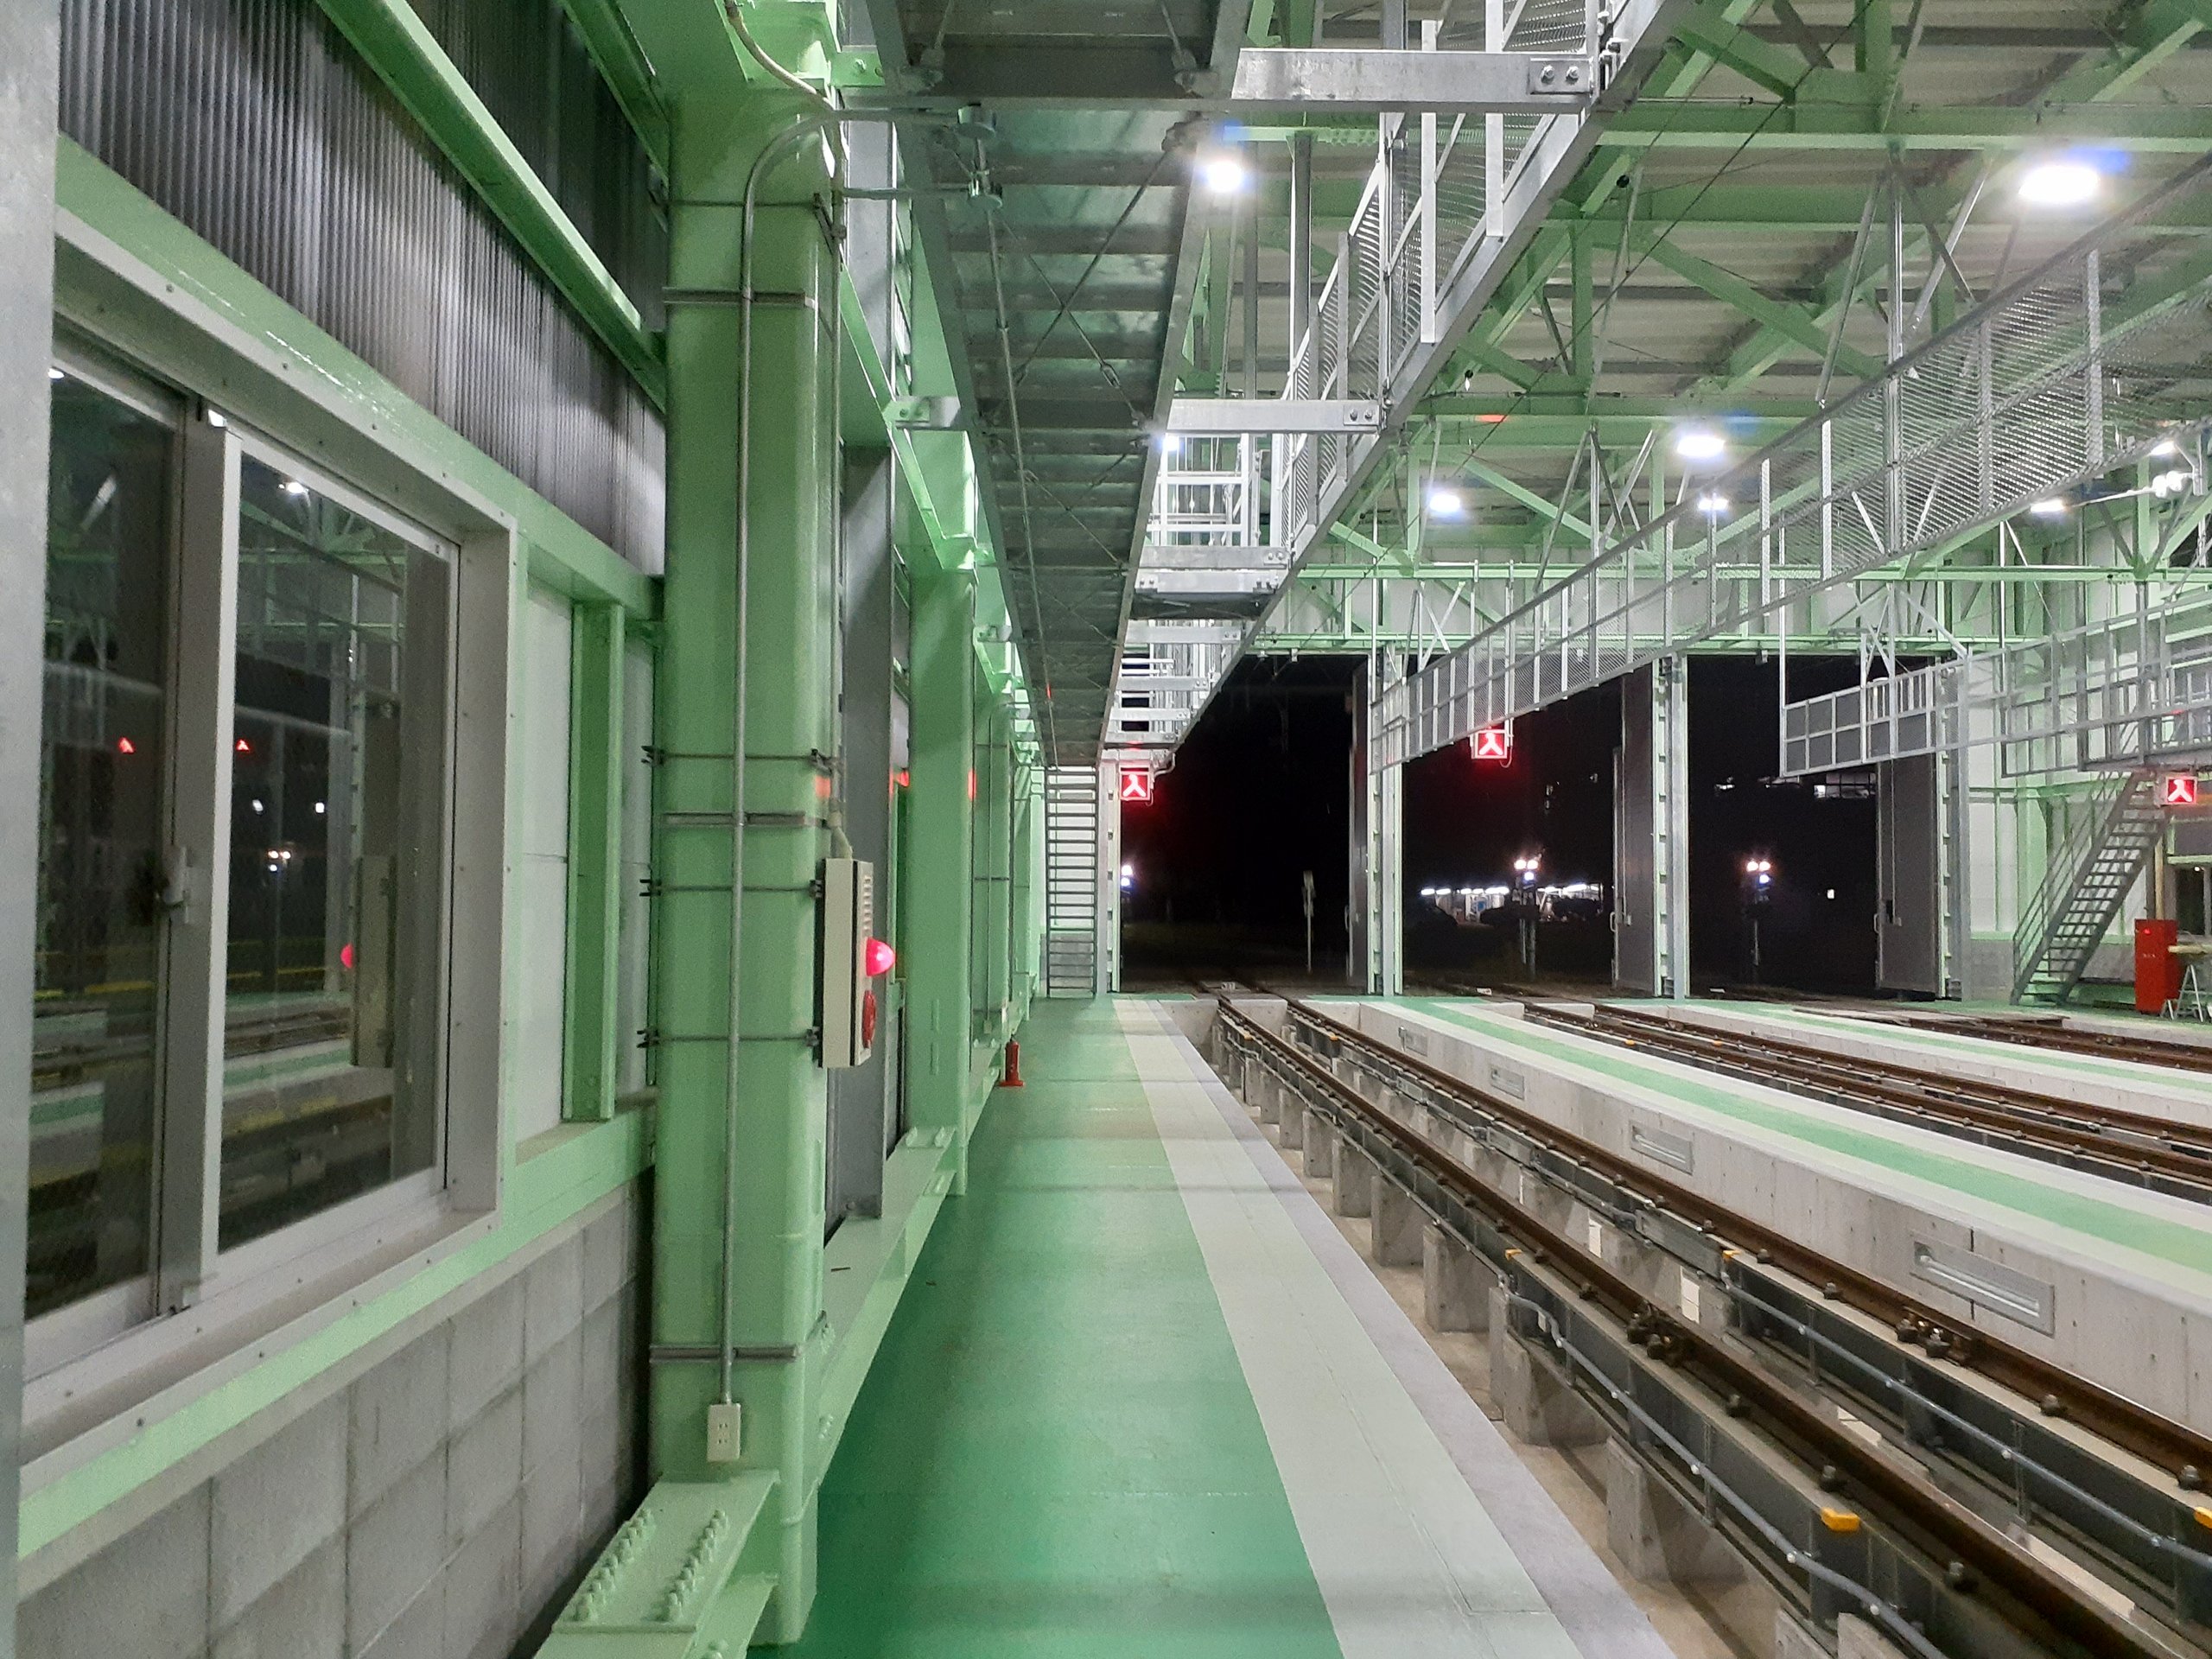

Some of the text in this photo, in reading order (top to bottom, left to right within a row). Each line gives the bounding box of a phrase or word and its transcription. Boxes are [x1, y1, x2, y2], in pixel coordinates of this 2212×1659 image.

[1478, 732, 1503, 756] 入
[1122, 774, 1147, 798] 入
[2167, 779, 2193, 803] 入
